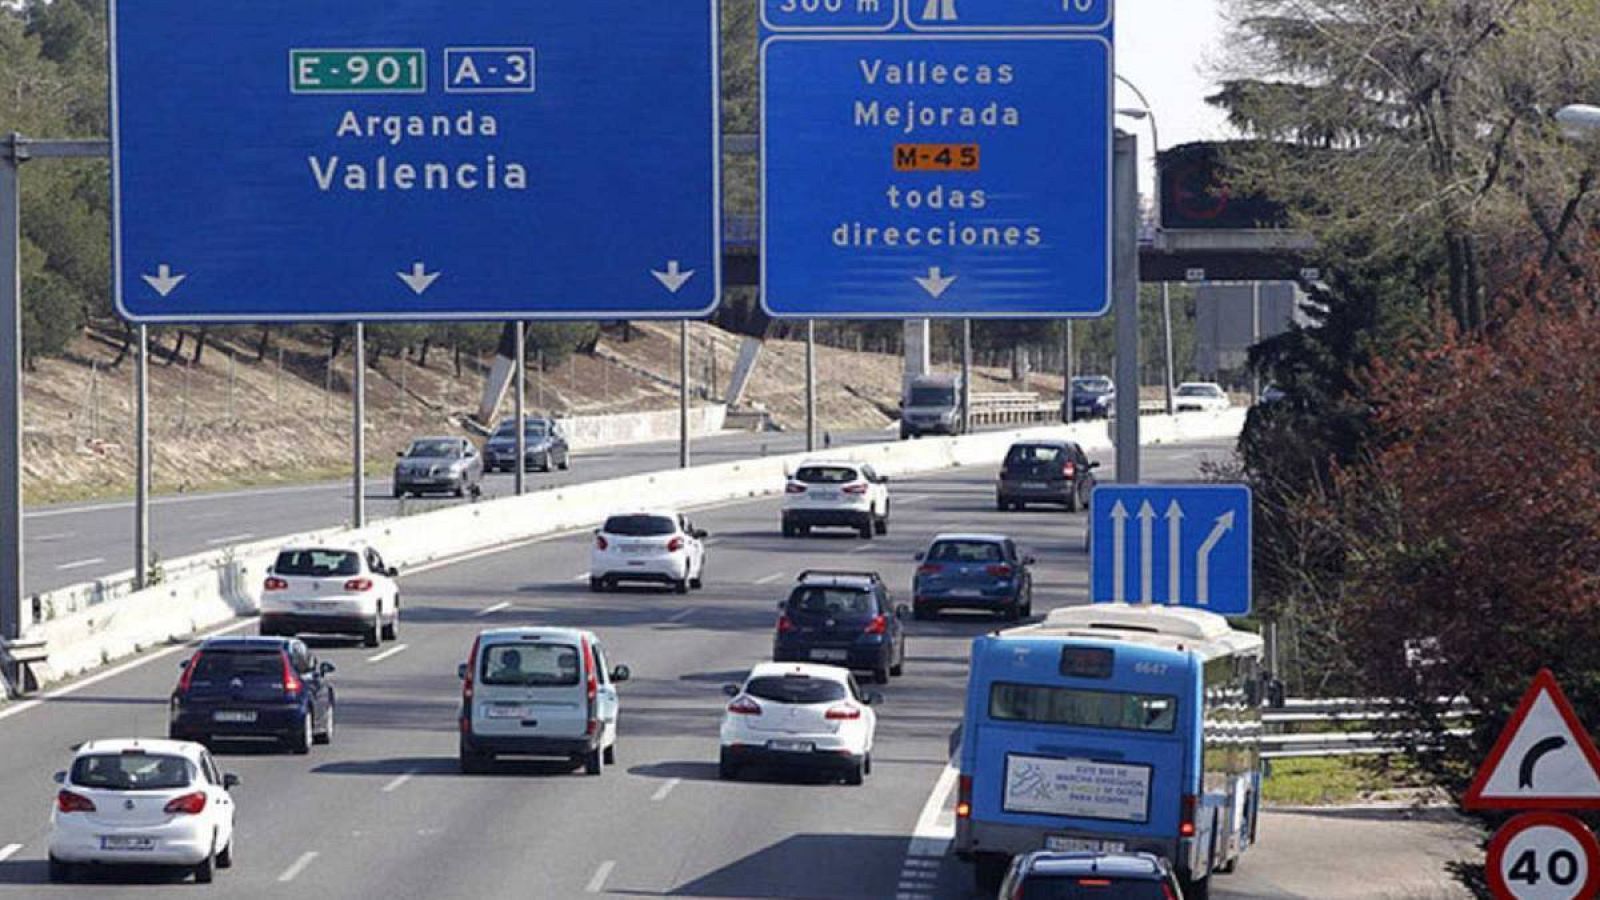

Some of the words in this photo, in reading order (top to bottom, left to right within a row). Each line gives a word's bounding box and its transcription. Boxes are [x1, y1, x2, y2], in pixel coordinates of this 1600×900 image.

[299, 56, 419, 85] E-901
[454, 55, 527, 84] A-3
[860, 59, 1013, 84] Vallecas
[337, 110, 497, 144] Arganda
[855, 101, 1018, 132] Mejorada
[896, 147, 976, 167] M-45
[308, 155, 527, 190] Valencia
[887, 185, 986, 208] todas
[832, 222, 1041, 246] direcciones
[1508, 850, 1579, 885] 40
